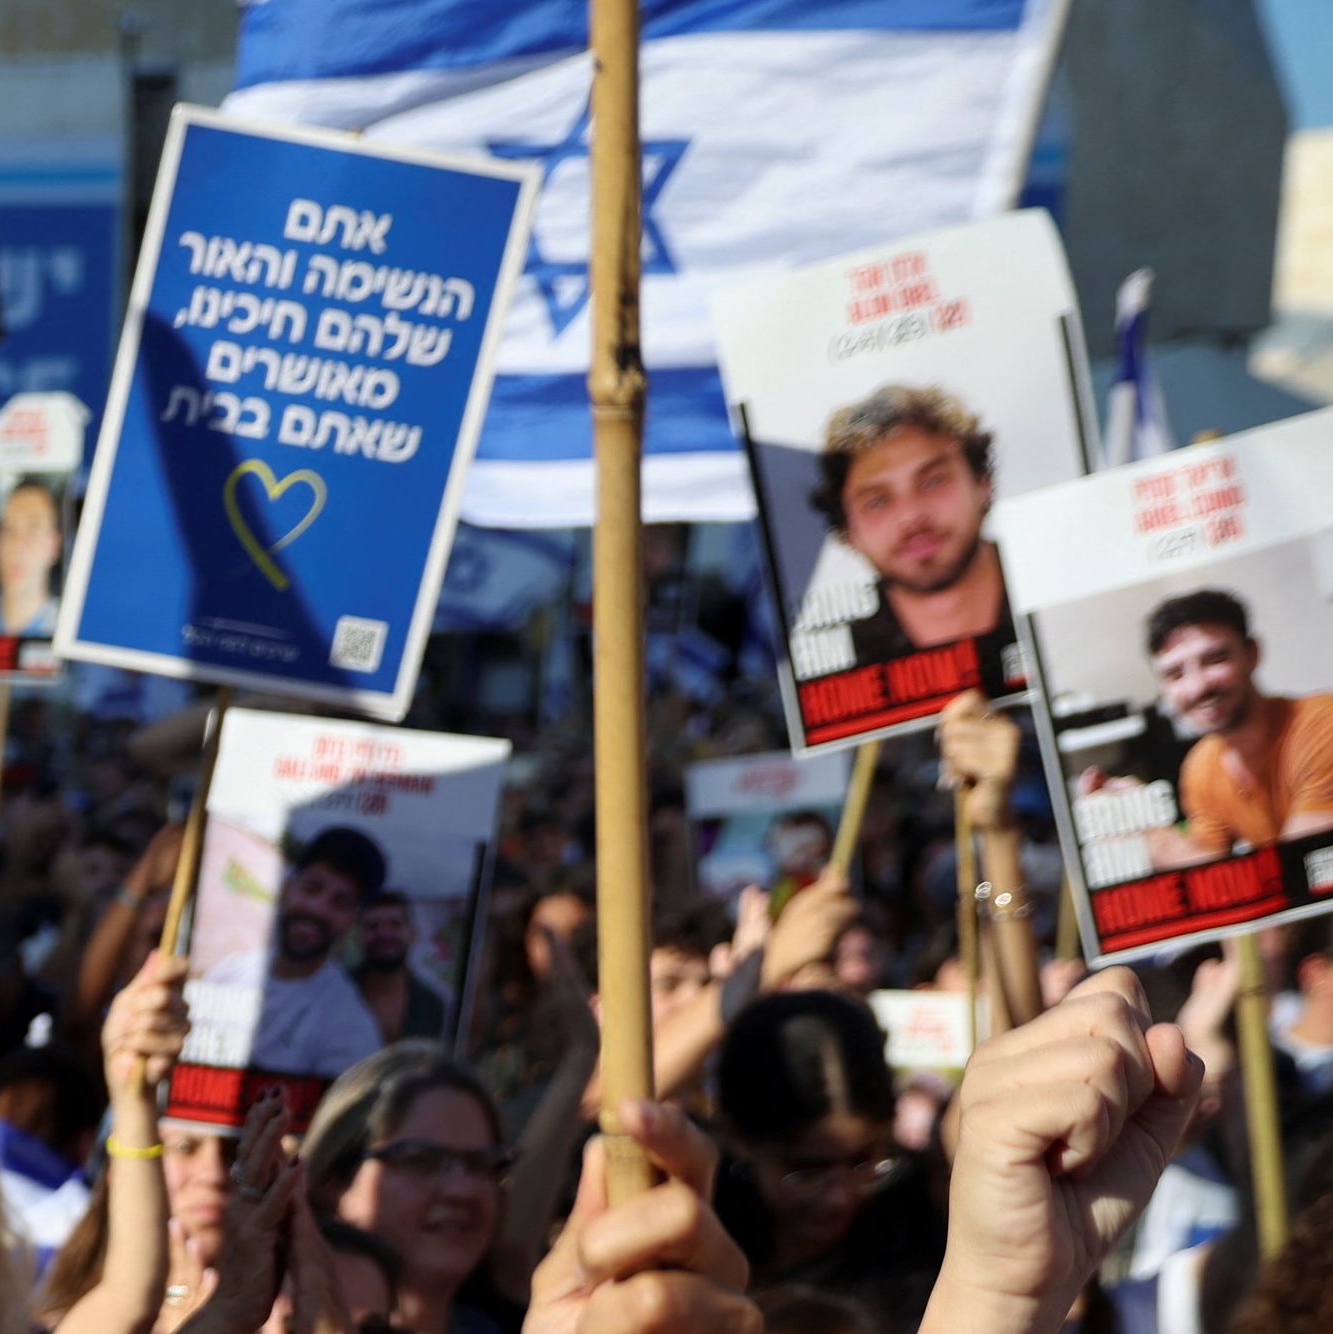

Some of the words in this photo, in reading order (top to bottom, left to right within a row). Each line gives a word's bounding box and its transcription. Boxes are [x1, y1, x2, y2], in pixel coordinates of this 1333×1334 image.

[284, 198, 393, 255] אתם
[180, 231, 298, 290] והאור
[303, 254, 475, 321] הנשימה
[314, 307, 453, 367] שלהם
[206, 339, 401, 410] מאושרים
[160, 385, 273, 440] בבית
[277, 403, 423, 465] שאתם
